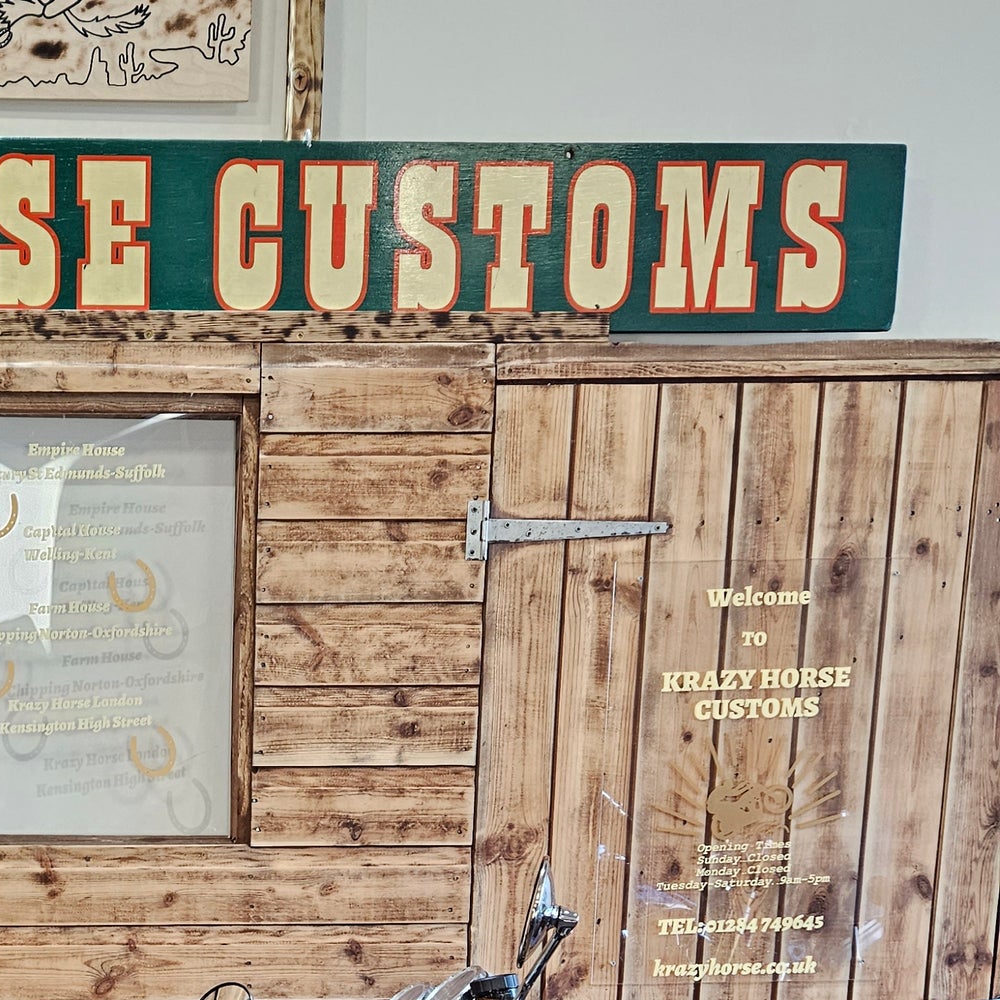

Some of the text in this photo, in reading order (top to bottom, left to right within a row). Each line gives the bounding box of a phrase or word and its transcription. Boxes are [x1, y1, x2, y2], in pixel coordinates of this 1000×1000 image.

[213, 158, 848, 314] CUSTOMS
[28, 442, 126, 458] Empire House
[44, 464, 166, 483] Edmunds-Suffolk
[23, 524, 77, 542] Capital
[78, 523, 121, 537] House
[24, 547, 117, 563] Welling-Kent
[707, 585, 811, 608] Welcome
[29, 601, 110, 615] Farm House
[39, 621, 173, 641] Norton-Oxfordshire
[741, 631, 768, 647] TO
[661, 666, 852, 693] KRAZY HORSE
[8, 694, 143, 715] Krazy Horse London
[693, 696, 820, 720] CUSTOMS
[0, 714, 152, 736] Kensington High Street
[697, 841, 749, 855] Opening
[760, 914, 825, 932] 749645
[653, 955, 817, 981] krazyhorse.co.uk
